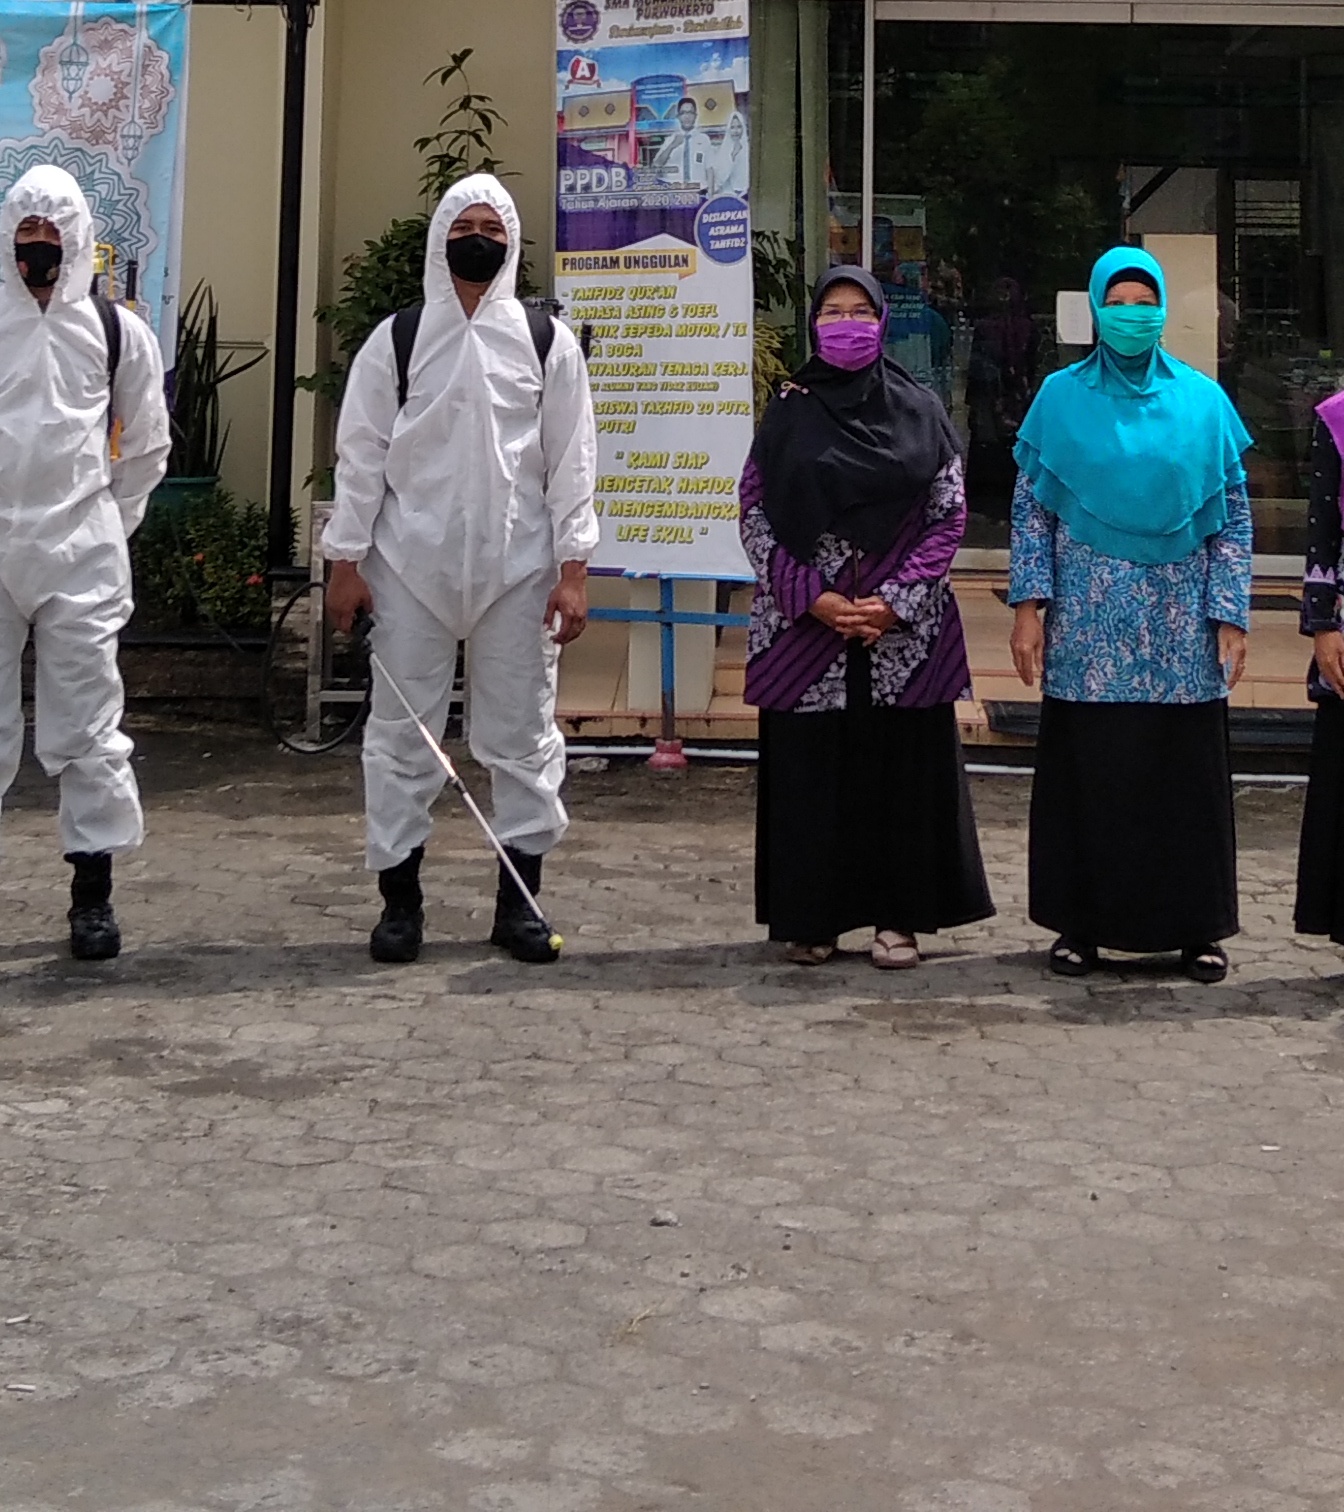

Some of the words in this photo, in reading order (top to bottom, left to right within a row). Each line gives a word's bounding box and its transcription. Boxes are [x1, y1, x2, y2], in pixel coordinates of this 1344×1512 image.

[635, 2, 714, 21] PURWOKERTO
[575, 60, 593, 79] A
[559, 166, 627, 194] PPDB
[561, 197, 595, 210] Tahun
[597, 195, 639, 210] Ajaran
[702, 209, 748, 224] DISIAPKAN
[708, 223, 745, 237] ASRAMA
[561, 257, 621, 271] PROGRAM
[623, 254, 690, 270] UNGGULAN
[571, 286, 625, 302] TAHFIDZ
[627, 285, 678, 302] QUR'AN
[571, 306, 622, 321] BAHASA
[625, 305, 666, 320] ASING
[681, 303, 719, 319] TOEFL
[621, 324, 673, 339] SEPEDA
[675, 323, 721, 339] MOTOR
[606, 343, 644, 358] BOGA
[587, 361, 658, 377] NYALURAN
[660, 361, 710, 377] TENAGA
[712, 361, 749, 377] KERJ
[597, 419, 637, 434] PUTRI
[626, 451, 671, 470] KAMI
[672, 451, 710, 470] SIAP
[676, 476, 736, 496] HAFIDZ
[607, 499, 743, 522] MENGEMBANGKA
[616, 523, 650, 543] LIFE
[651, 524, 695, 545] SKILL
